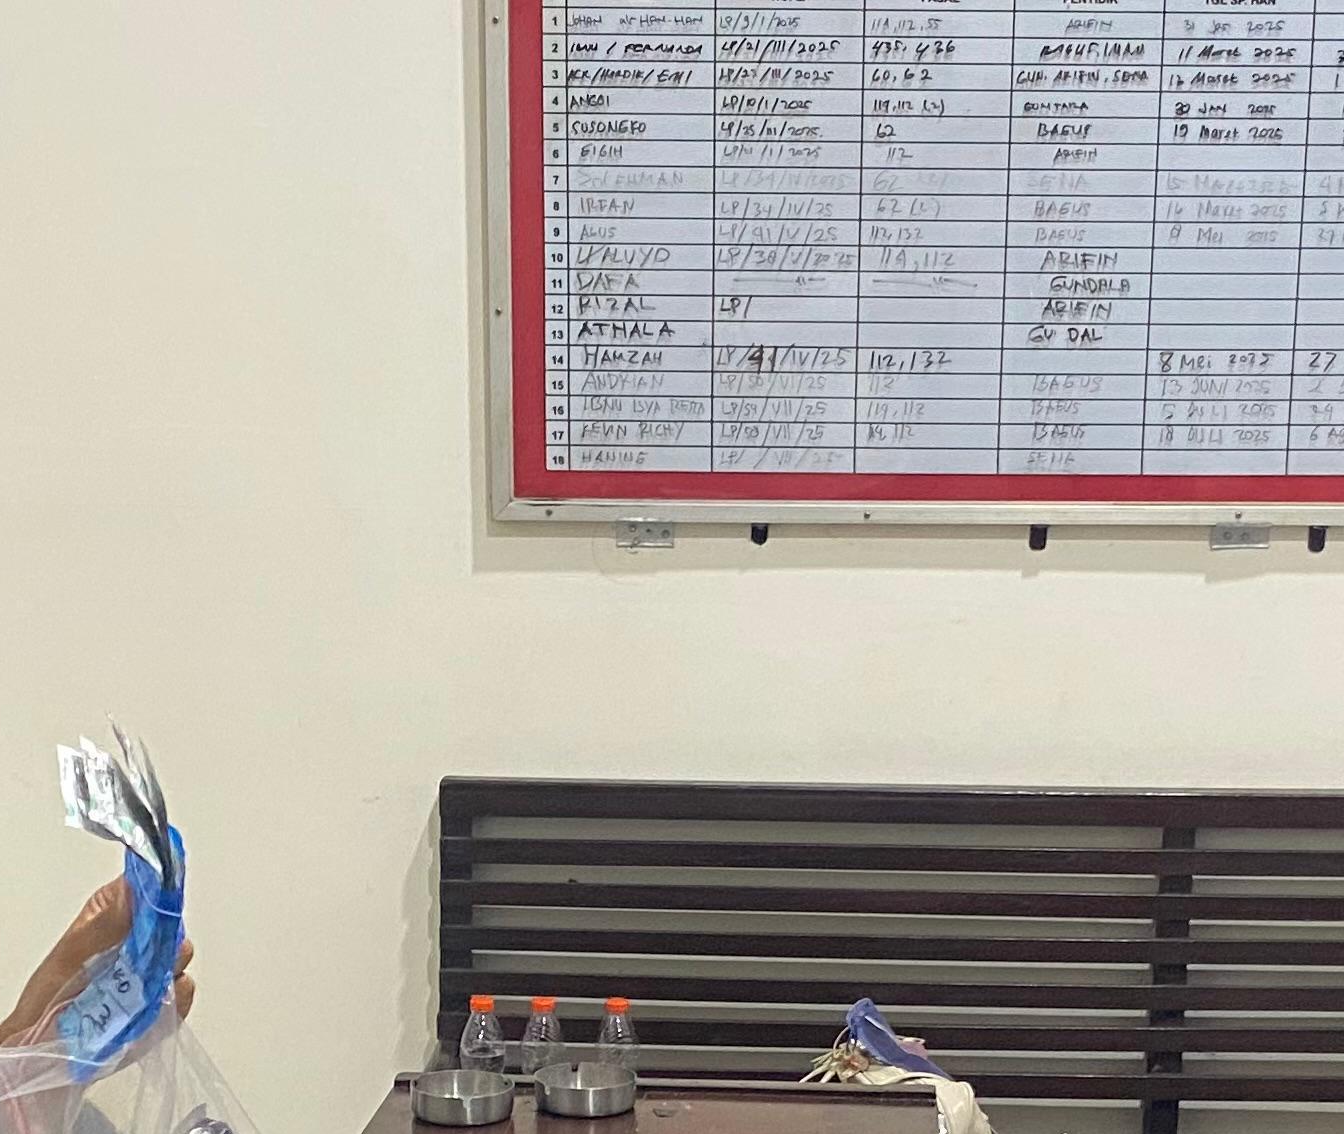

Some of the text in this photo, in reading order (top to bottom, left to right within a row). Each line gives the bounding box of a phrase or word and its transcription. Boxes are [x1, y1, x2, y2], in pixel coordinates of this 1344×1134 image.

[552, 16, 559, 26] 1
[552, 43, 559, 53] 2
[1255, 47, 1297, 60] 2025
[552, 69, 559, 79] 3
[552, 96, 559, 106] 4
[552, 123, 559, 133] 5
[876, 124, 897, 138] 62
[1200, 125, 1239, 139] Maret
[552, 148, 559, 159] 6
[552, 175, 559, 185] 7
[553, 201, 560, 211] 8
[553, 227, 560, 237] 9
[552, 252, 563, 263] 10
[1041, 251, 1119, 270] ARIFIN
[552, 278, 563, 289] 11
[1050, 275, 1131, 293] GUNDALA
[552, 304, 563, 315] 12
[1042, 299, 1112, 321] ARIFIN
[552, 330, 564, 340] 13
[576, 321, 676, 343] ATHALA
[552, 354, 564, 365] 14
[582, 344, 663, 372] HAMZAH
[1180, 352, 1212, 370] Mei
[1308, 351, 1338, 373] 27
[552, 380, 564, 390] 15
[552, 405, 564, 415] 16
[552, 430, 564, 441] 17
[552, 456, 564, 466] 18
